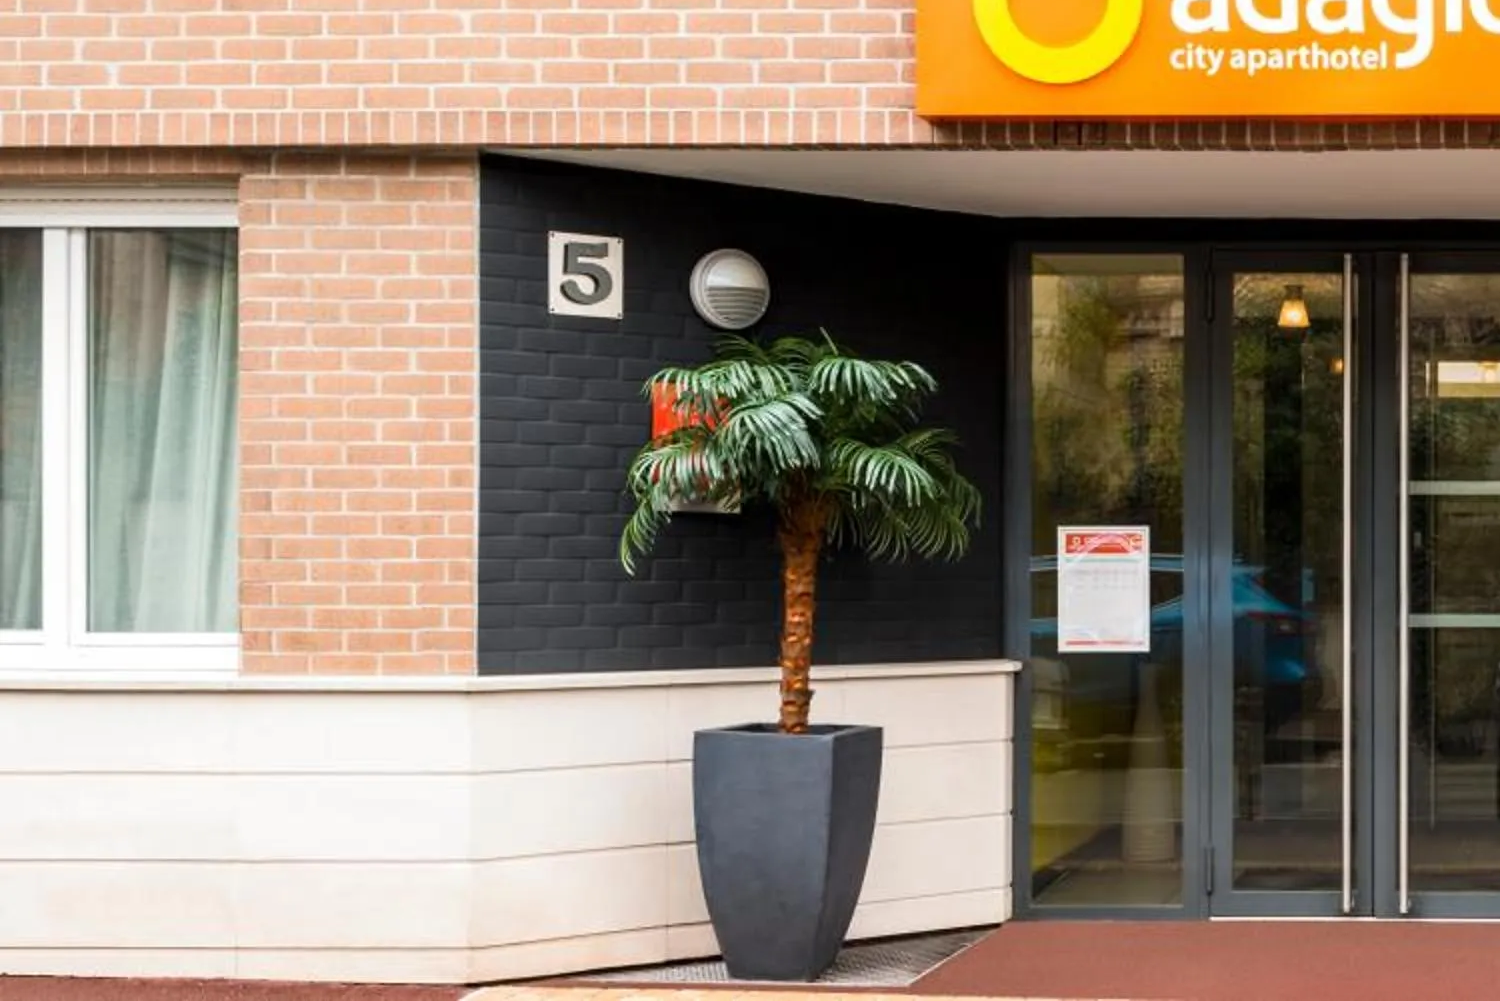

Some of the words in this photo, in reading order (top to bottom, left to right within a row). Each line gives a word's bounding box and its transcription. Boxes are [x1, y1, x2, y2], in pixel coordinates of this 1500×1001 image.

[1169, 43, 1225, 76] city
[1229, 41, 1388, 76] aparthotel
[559, 242, 614, 305] 5
